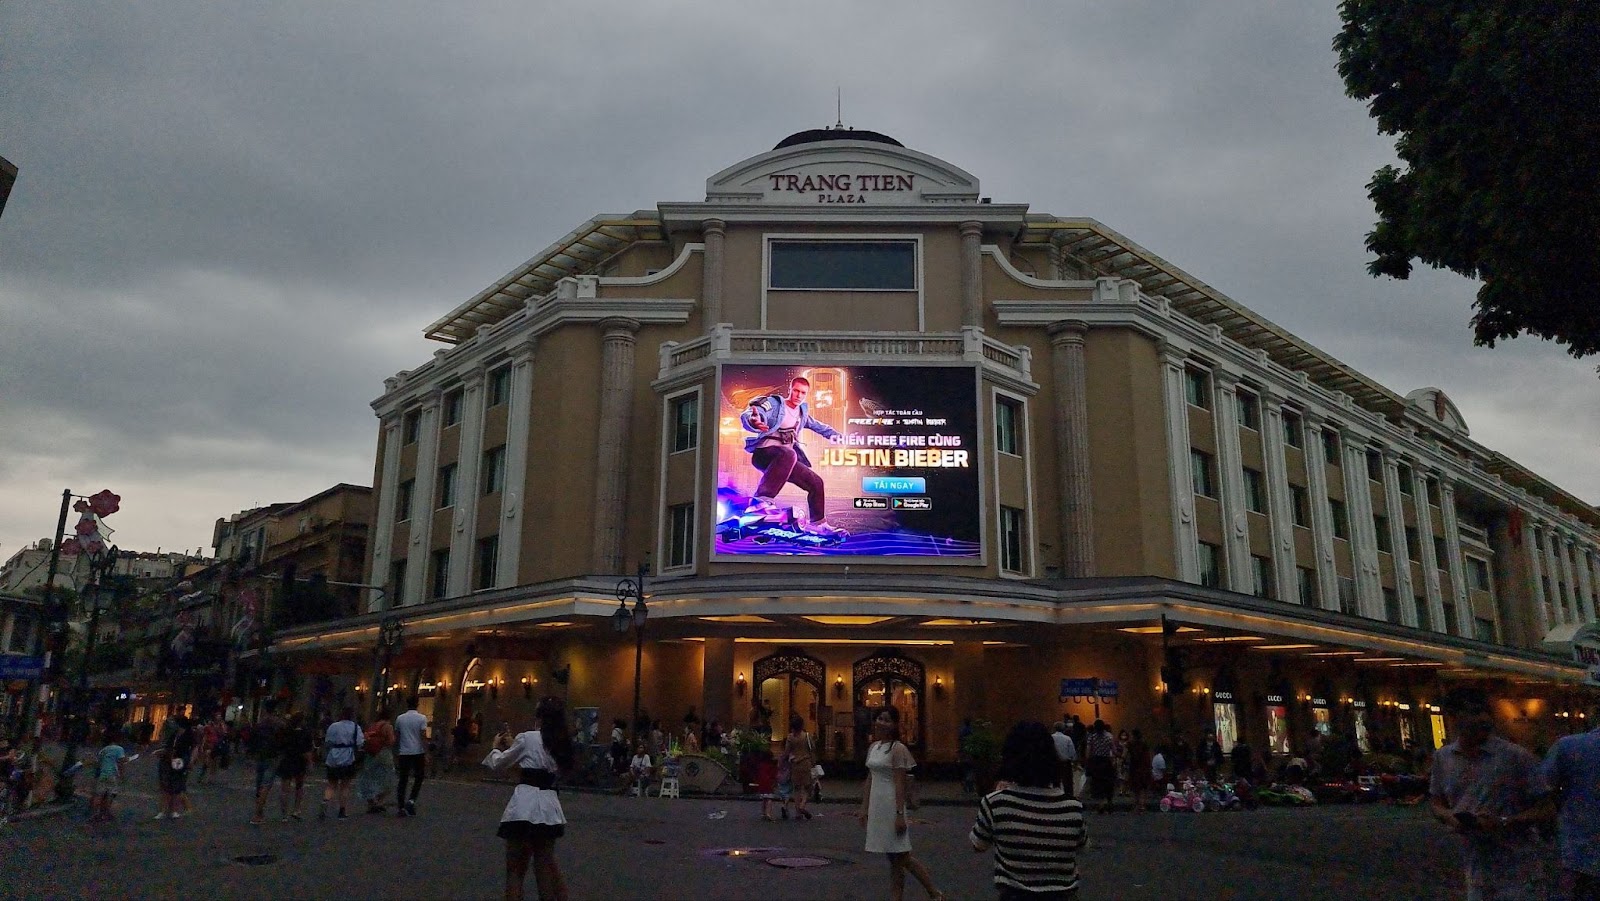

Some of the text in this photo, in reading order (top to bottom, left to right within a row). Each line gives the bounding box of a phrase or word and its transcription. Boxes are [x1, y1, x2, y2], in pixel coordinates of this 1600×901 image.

[769, 174, 915, 193] TRANG TIEN
[818, 194, 866, 204] PLAZA
[829, 432, 961, 447] CHIẾN FREE FIRE CÙNG
[820, 449, 969, 467] JUSTIN BIEBER
[890, 482, 914, 490] NGAY
